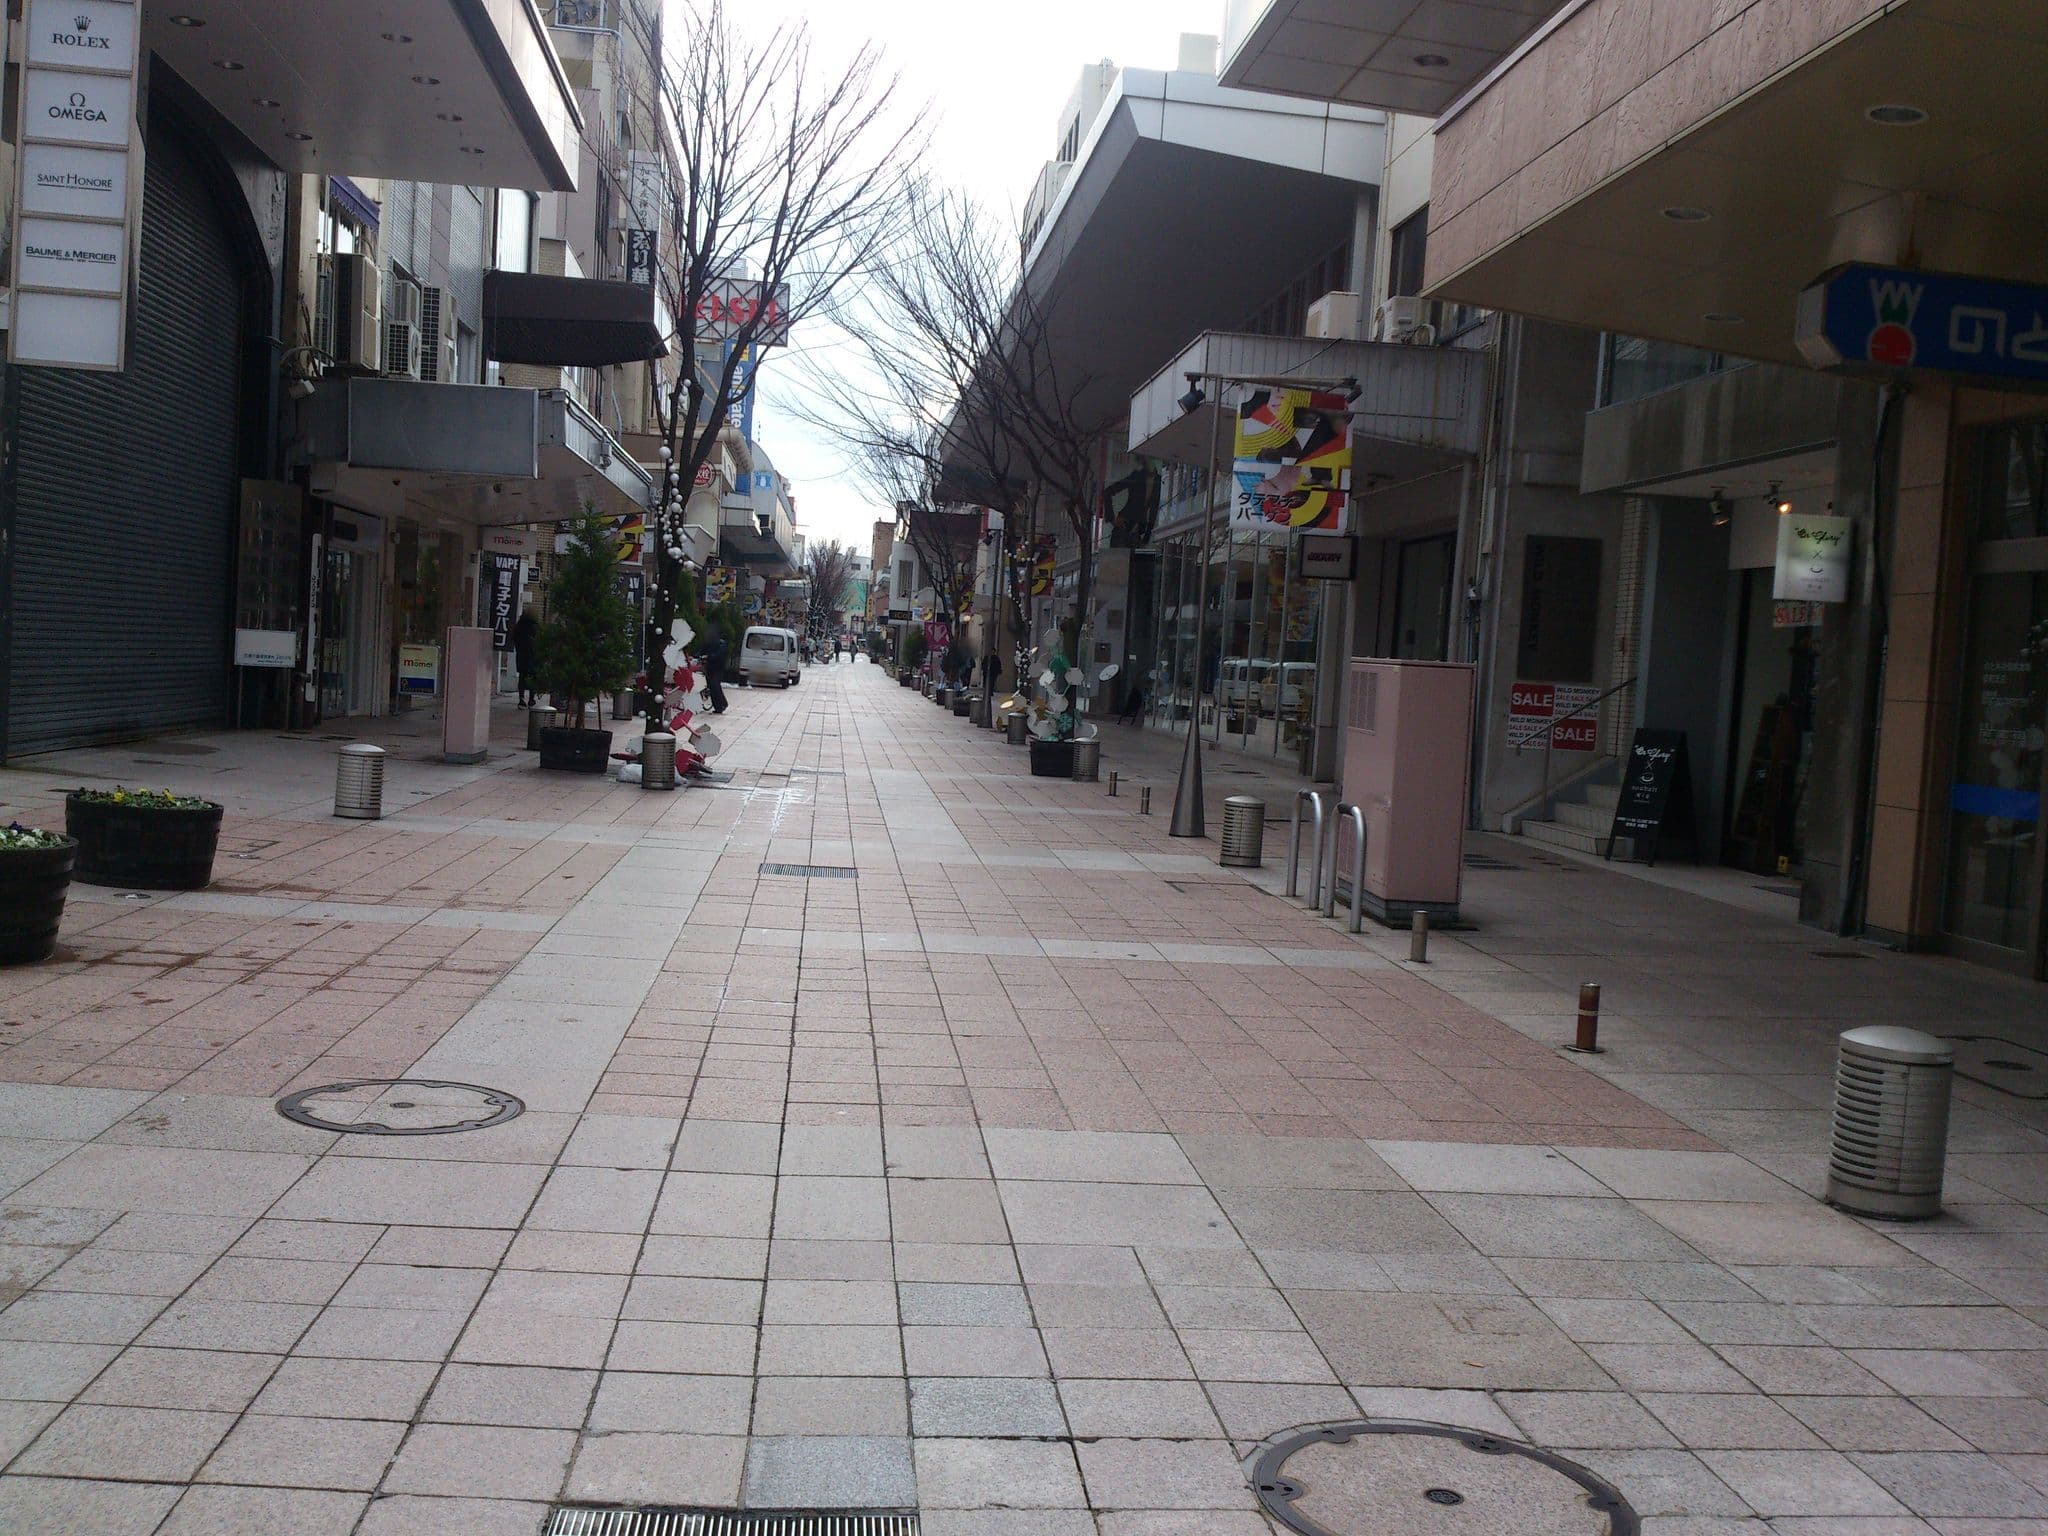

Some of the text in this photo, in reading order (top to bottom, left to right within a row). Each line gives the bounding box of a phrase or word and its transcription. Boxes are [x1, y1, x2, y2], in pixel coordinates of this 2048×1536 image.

[52, 33, 111, 50] ROLEX
[48, 106, 108, 123] OMEGA
[37, 174, 65, 184] SAINT
[26, 246, 63, 257] BAUME
[64, 250, 71, 258] &
[72, 250, 117, 262] MERCIER
[495, 556, 520, 570] VAPE
[494, 571, 512, 647] 電子タバコ
[1512, 692, 1553, 707] SALE
[1553, 726, 1597, 743] SALE
